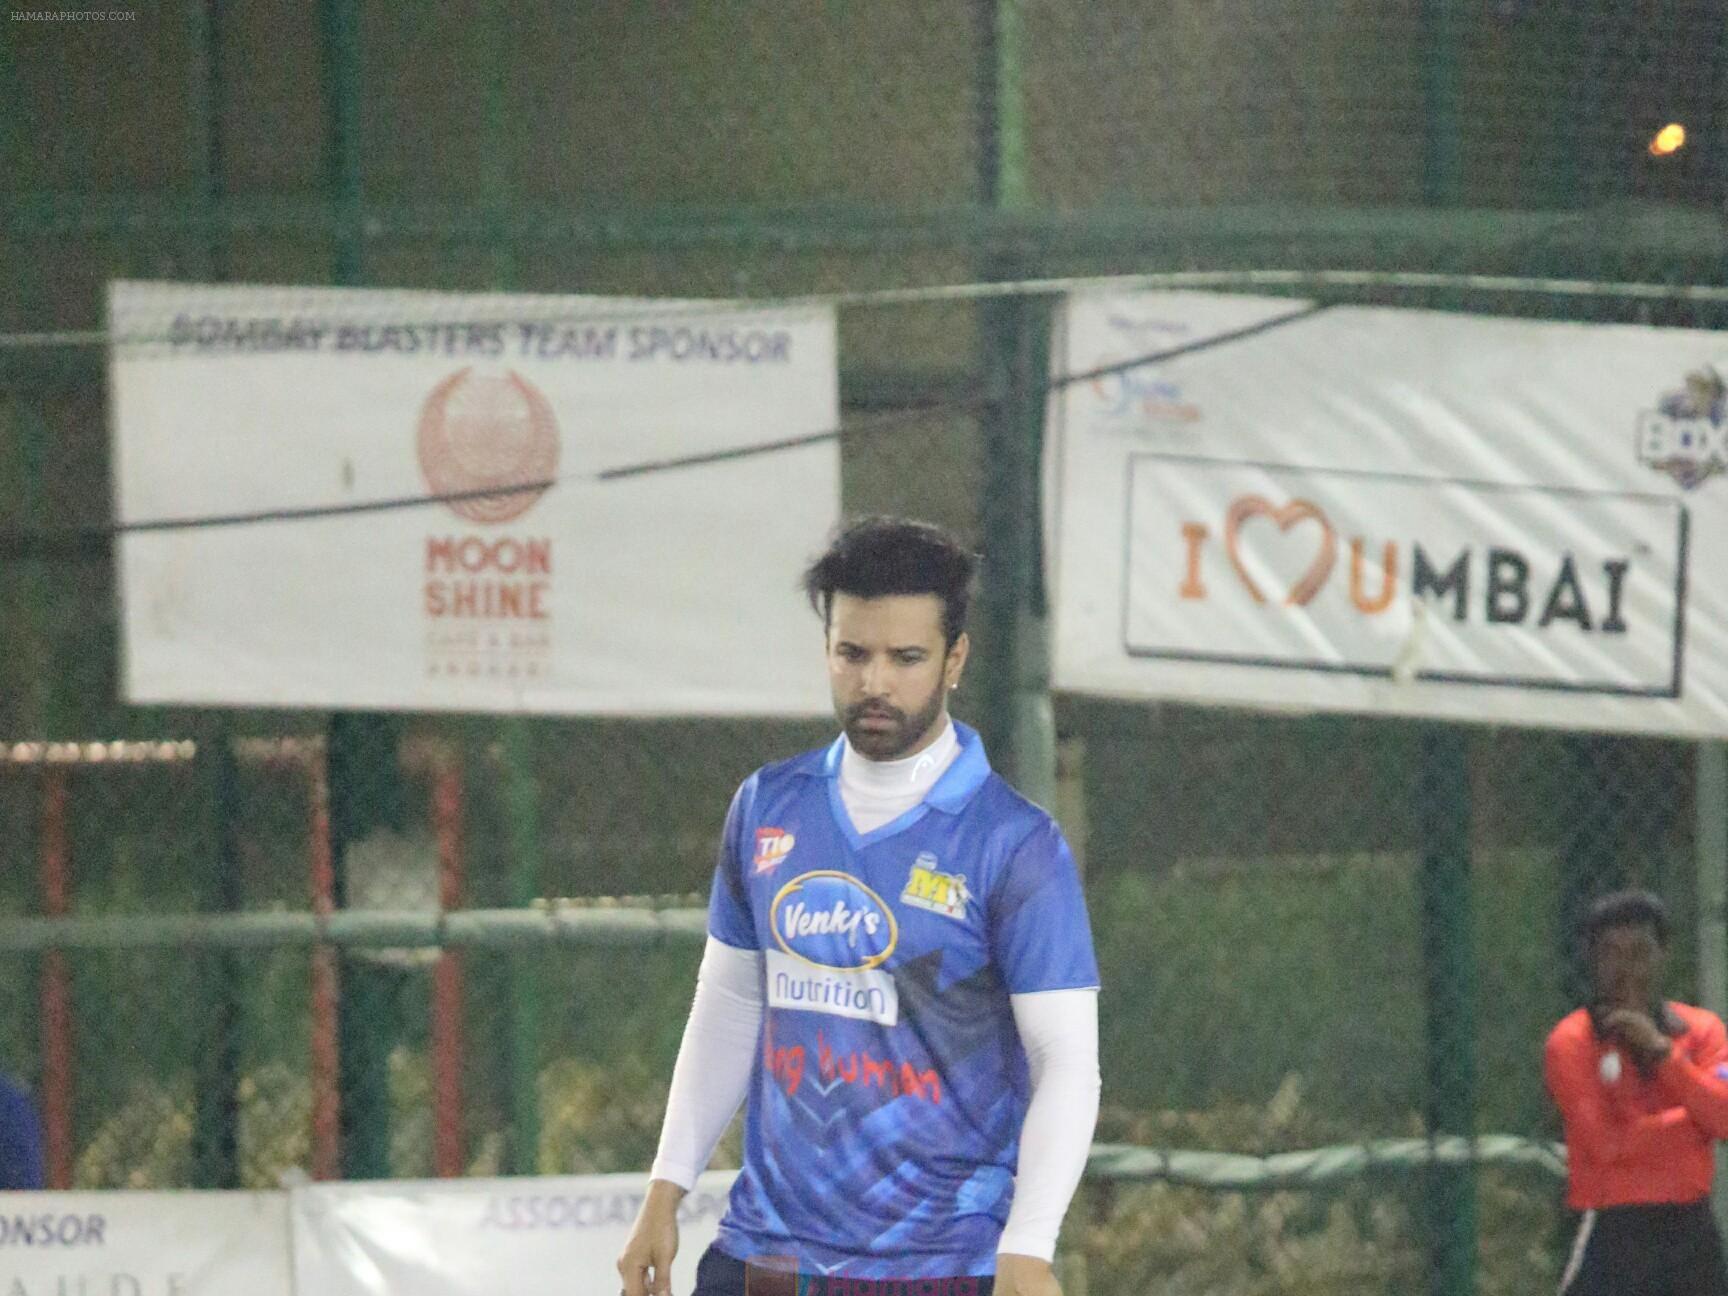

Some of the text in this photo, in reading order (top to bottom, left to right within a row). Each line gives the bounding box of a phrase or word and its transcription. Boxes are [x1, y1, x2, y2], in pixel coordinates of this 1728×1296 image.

[336, 322, 504, 355] BLASTERS
[518, 324, 617, 357] TEAM
[629, 327, 793, 363] SPONSOR
[426, 536, 552, 574] MOON
[426, 579, 551, 619] SHINE
[784, 900, 881, 950] Venky's
